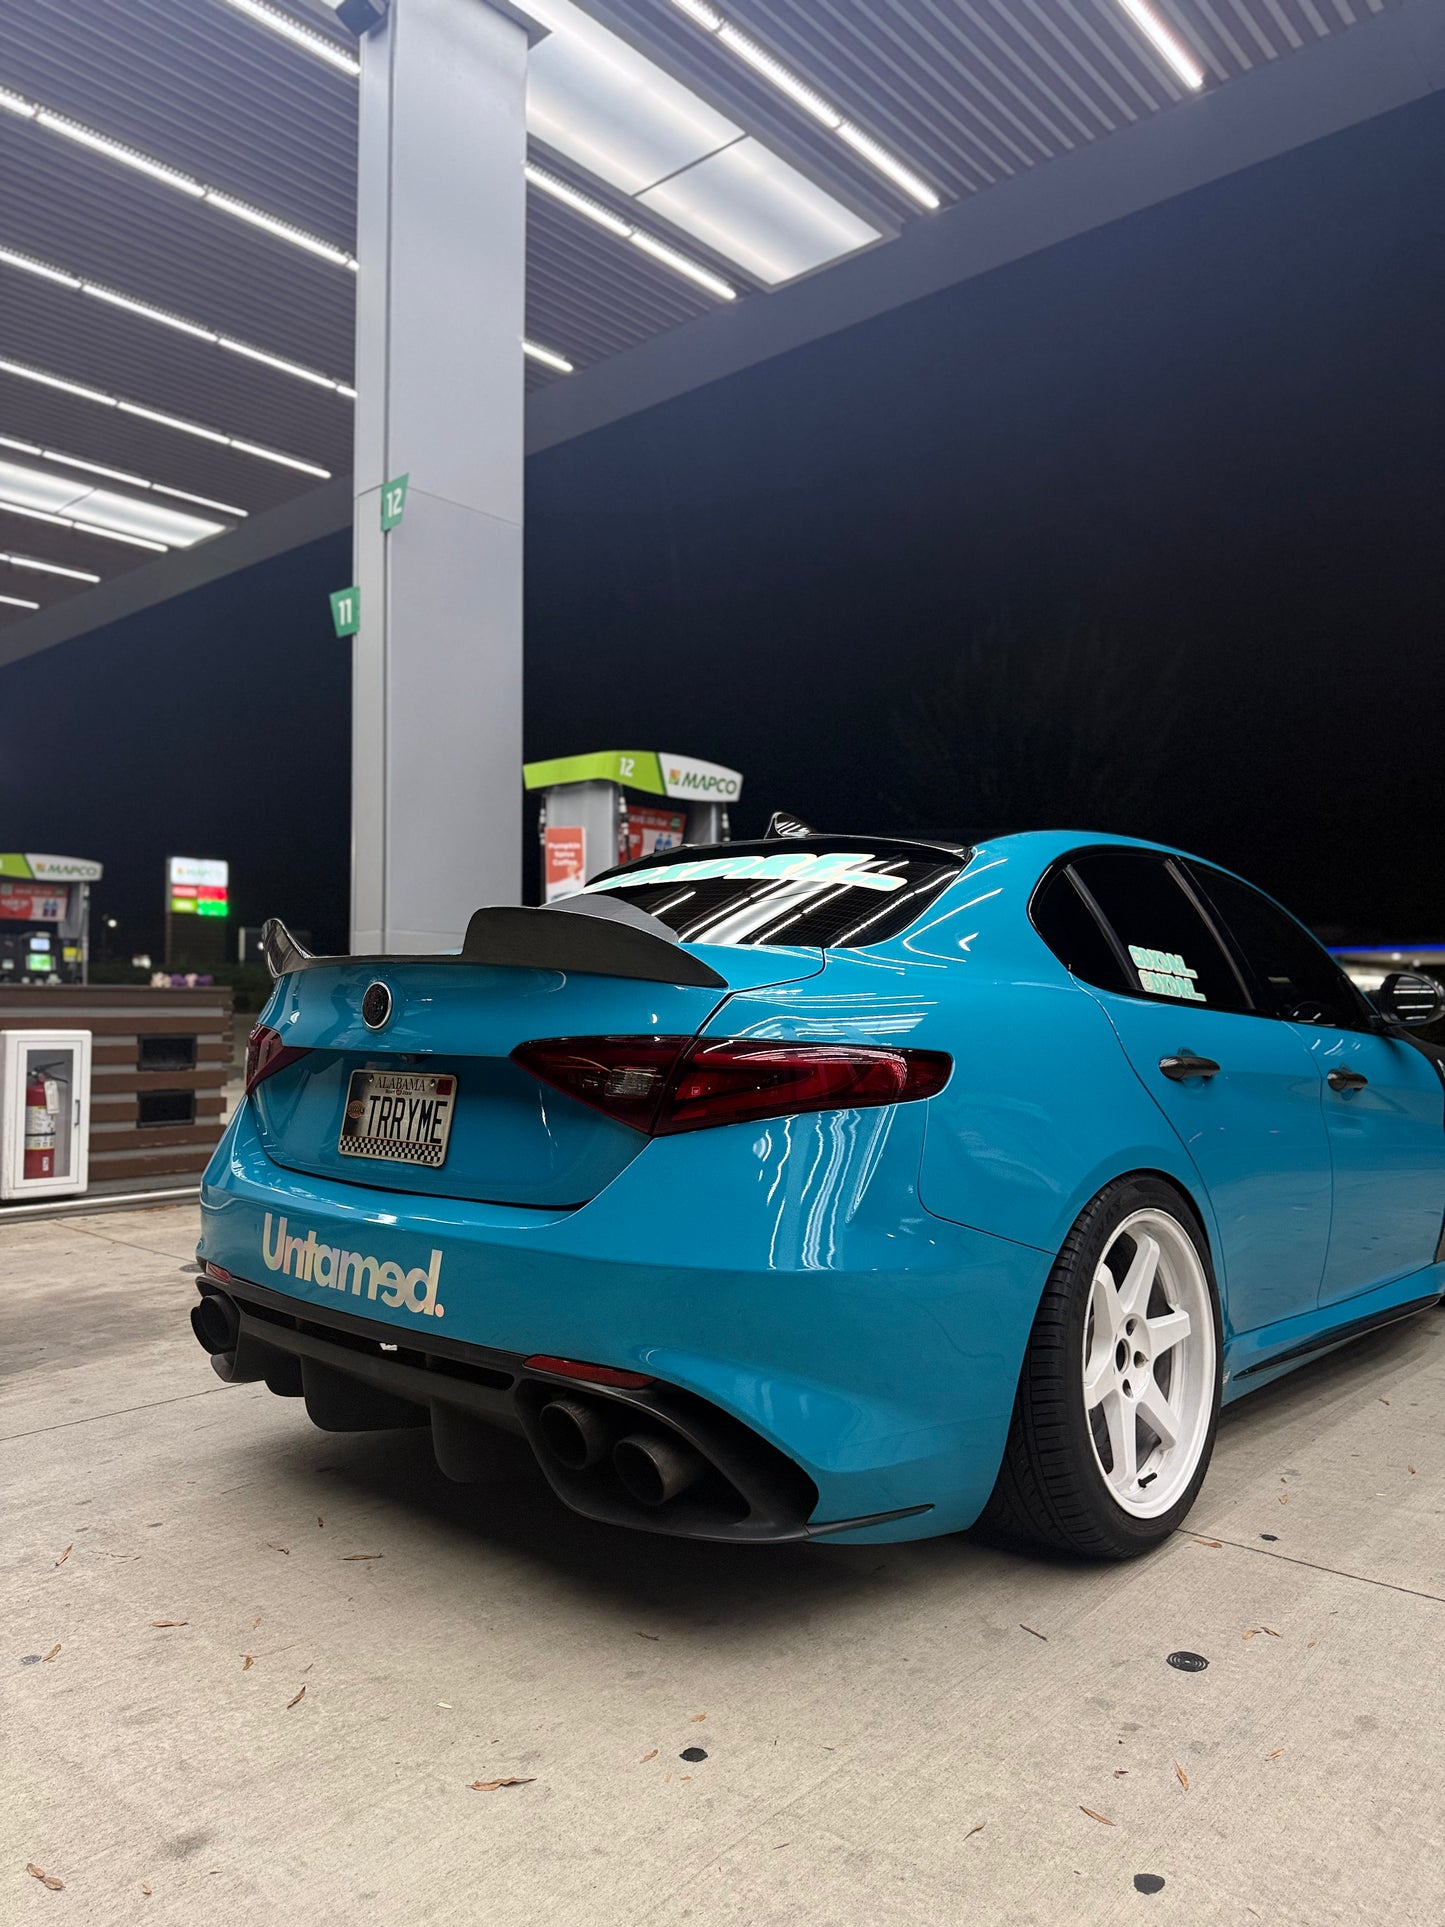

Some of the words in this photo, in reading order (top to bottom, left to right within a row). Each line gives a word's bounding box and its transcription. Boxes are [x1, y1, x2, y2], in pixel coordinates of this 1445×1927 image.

[386, 487, 403, 518] 12
[338, 598, 352, 626] 11
[619, 757, 635, 777] 12
[681, 771, 738, 795] MAPCO
[47, 864, 98, 877] MAPCO
[375, 1076, 425, 1092] ALABAMA
[367, 1095, 448, 1144] TRRYME
[262, 1212, 445, 1318] Untamed.
